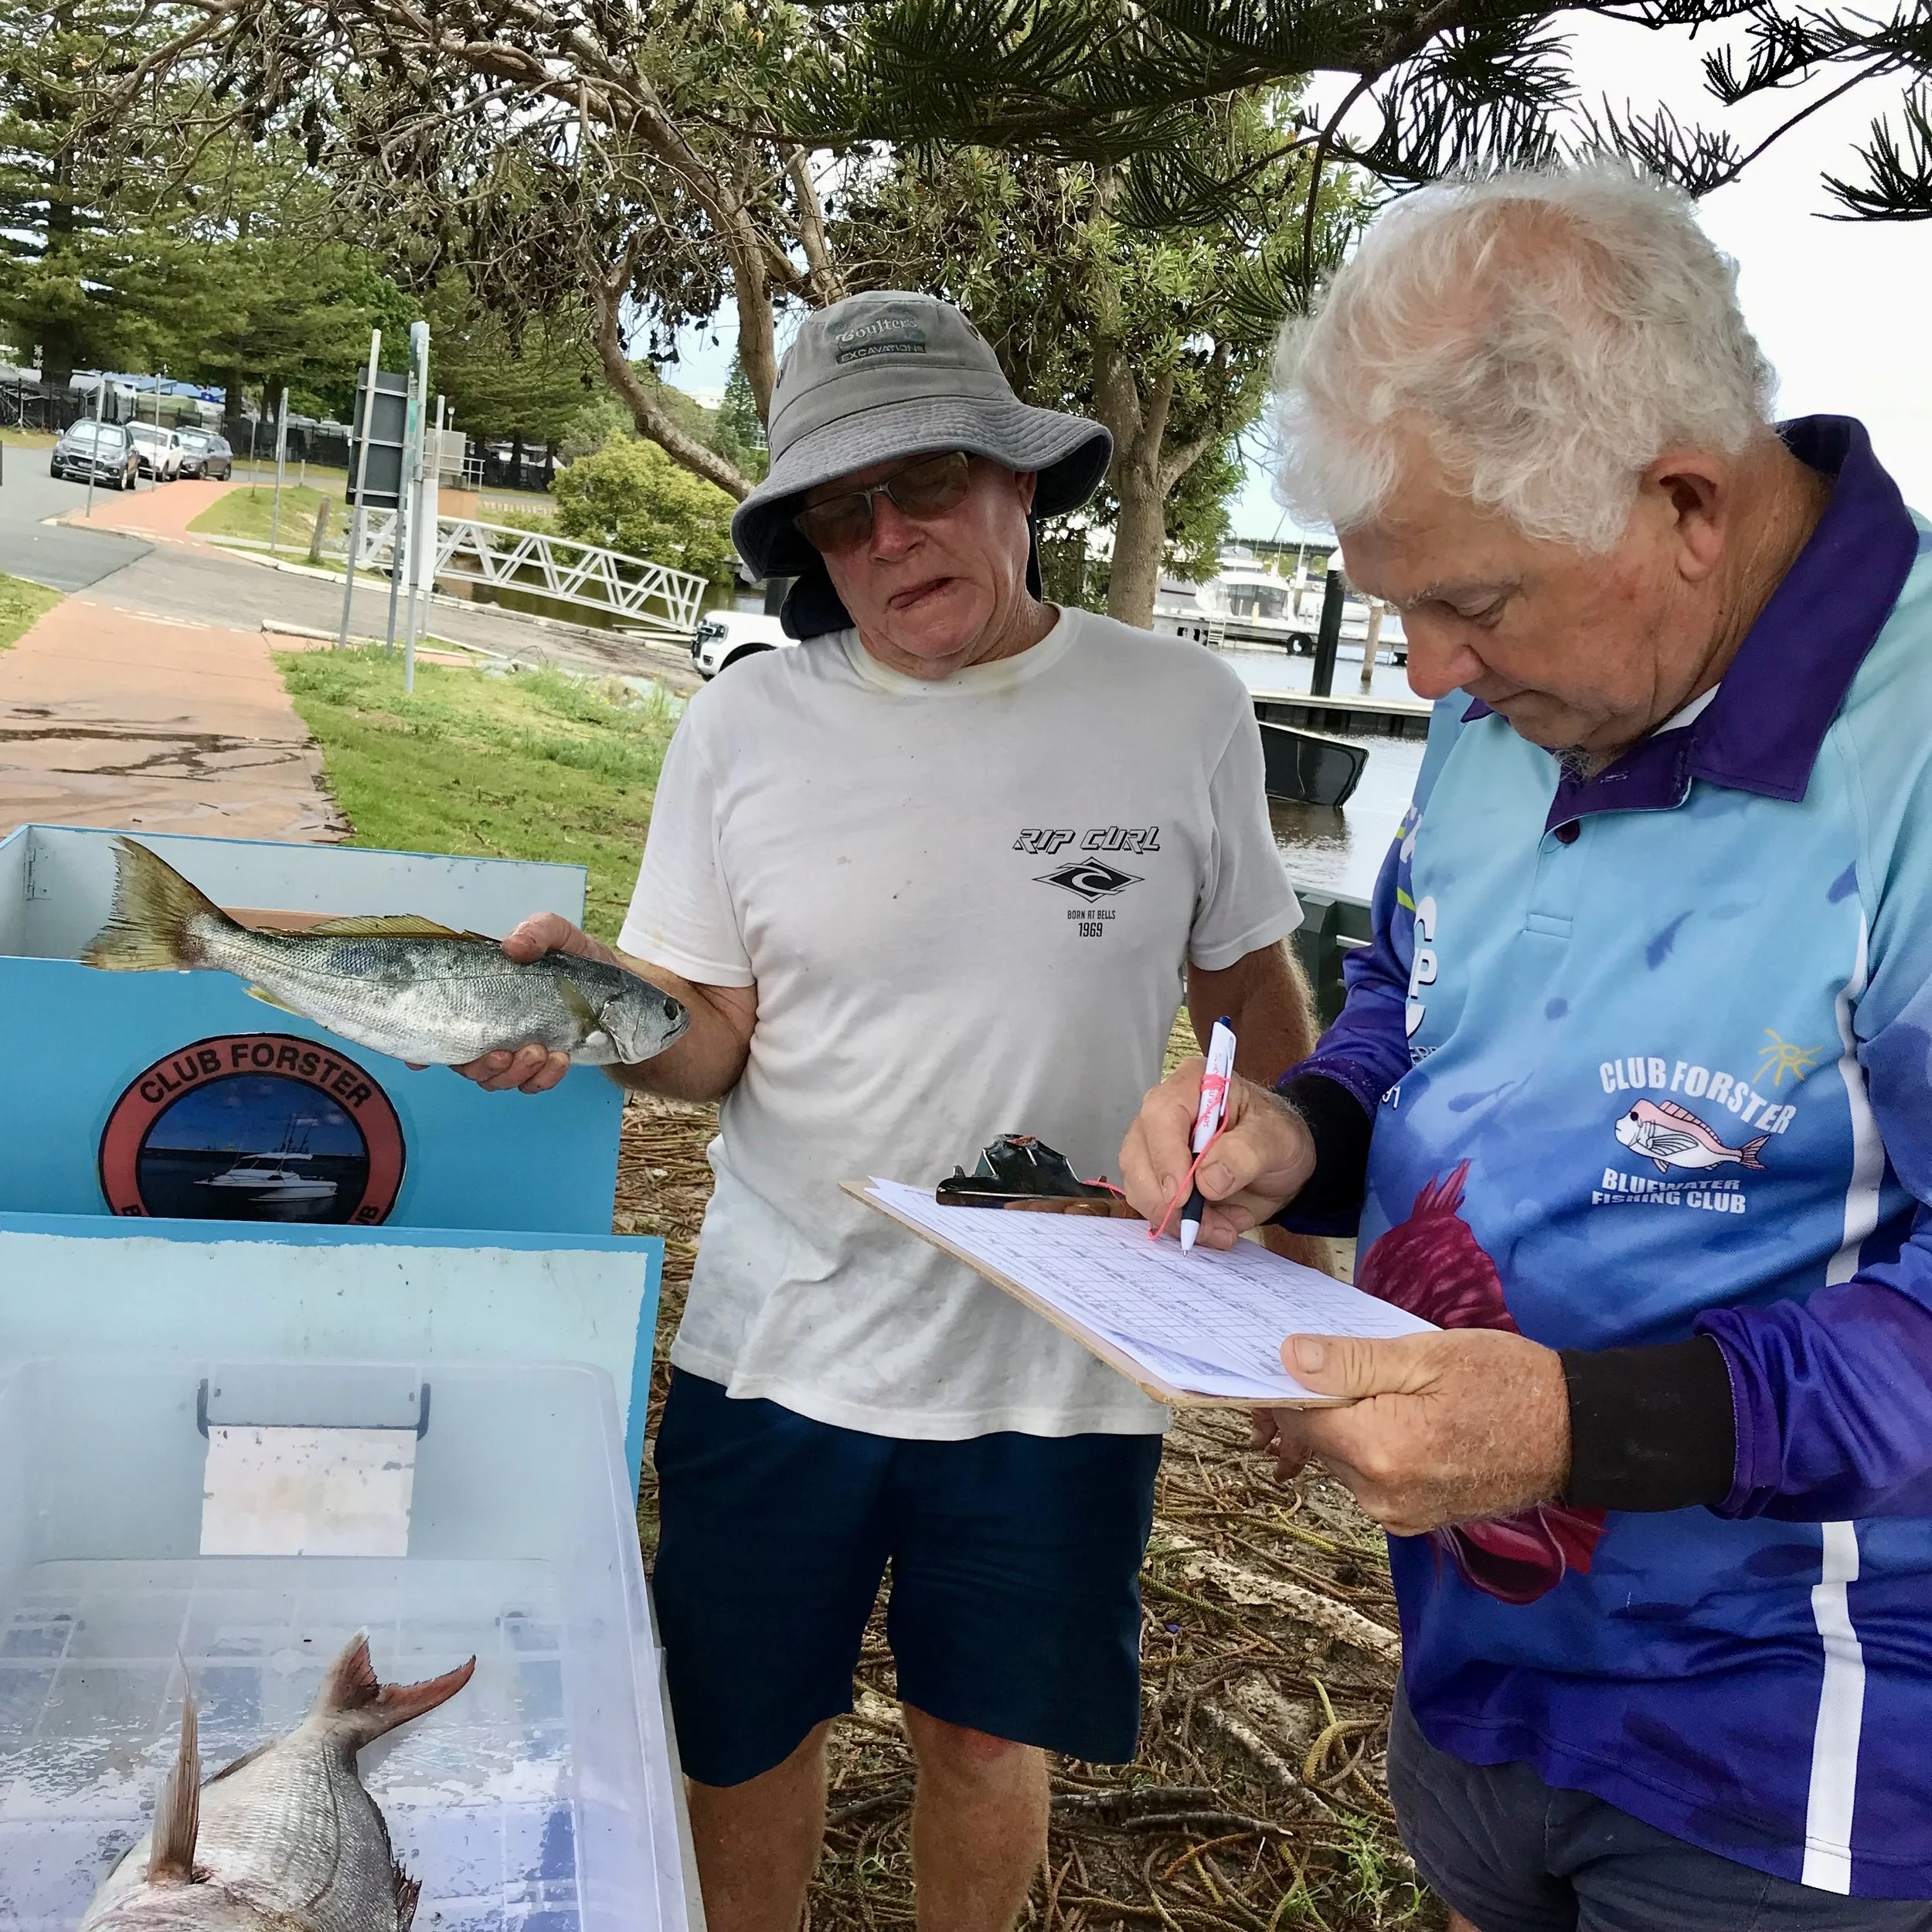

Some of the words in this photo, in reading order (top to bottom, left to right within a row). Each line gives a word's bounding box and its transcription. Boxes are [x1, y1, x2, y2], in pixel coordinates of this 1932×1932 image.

[1012, 828, 1076, 854] RIP
[1080, 826, 1160, 854] CURL
[1067, 910, 1085, 920] BORN
[1087, 910, 1095, 920] AT
[1097, 910, 1115, 920] BELLS
[1078, 922, 1103, 937] 1969
[140, 1049, 222, 1104] CLUB
[231, 1043, 372, 1108] FORSTER
[1599, 1056, 1667, 1094] CLUB
[1669, 1060, 1797, 1134] FORSTER
[1601, 1168, 1740, 1193] BLUEWATER
[1591, 1191, 1681, 1206] FISHING
[1686, 1191, 1747, 1214] CLUB
